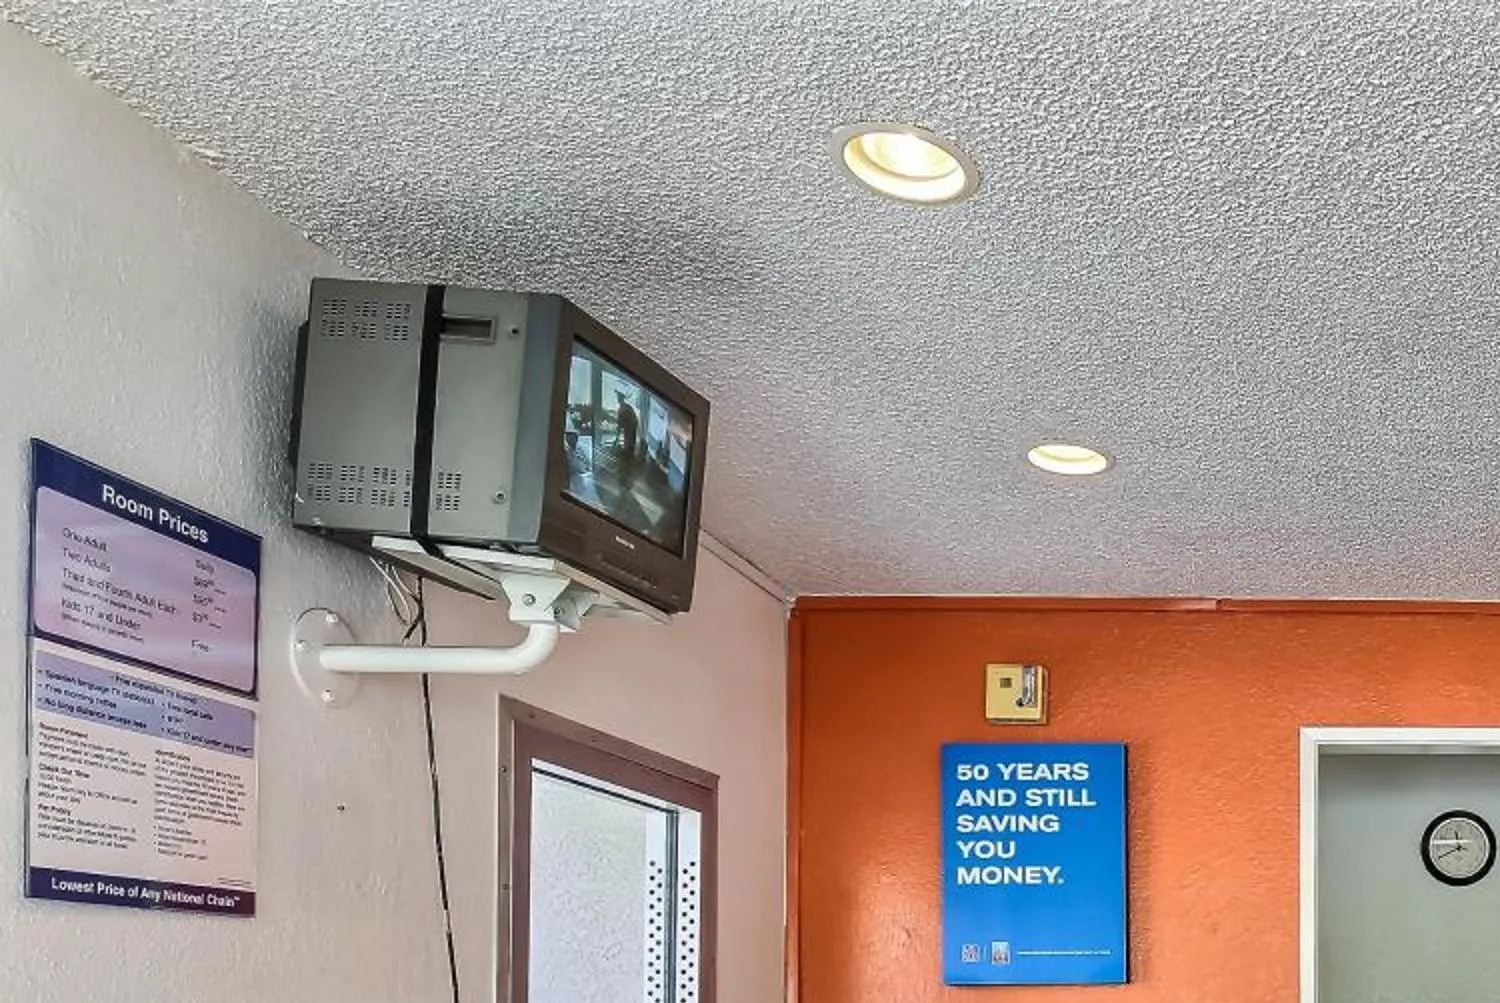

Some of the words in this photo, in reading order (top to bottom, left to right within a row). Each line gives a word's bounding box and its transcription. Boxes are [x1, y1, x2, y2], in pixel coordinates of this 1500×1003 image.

[101, 484, 153, 521] Room
[159, 509, 209, 544] Prices
[957, 764, 988, 781] 50
[996, 763, 1089, 781] YEARS
[956, 789, 1017, 807] AND
[1024, 788, 1096, 807] STILL
[956, 813, 1060, 833] SAVING
[956, 840, 1016, 859] YOU
[956, 866, 1064, 885] MONEY.
[51, 877, 95, 895] Lowest
[97, 881, 125, 898] Price
[128, 885, 140, 898] of
[141, 886, 161, 904] Any
[163, 889, 206, 905] National
